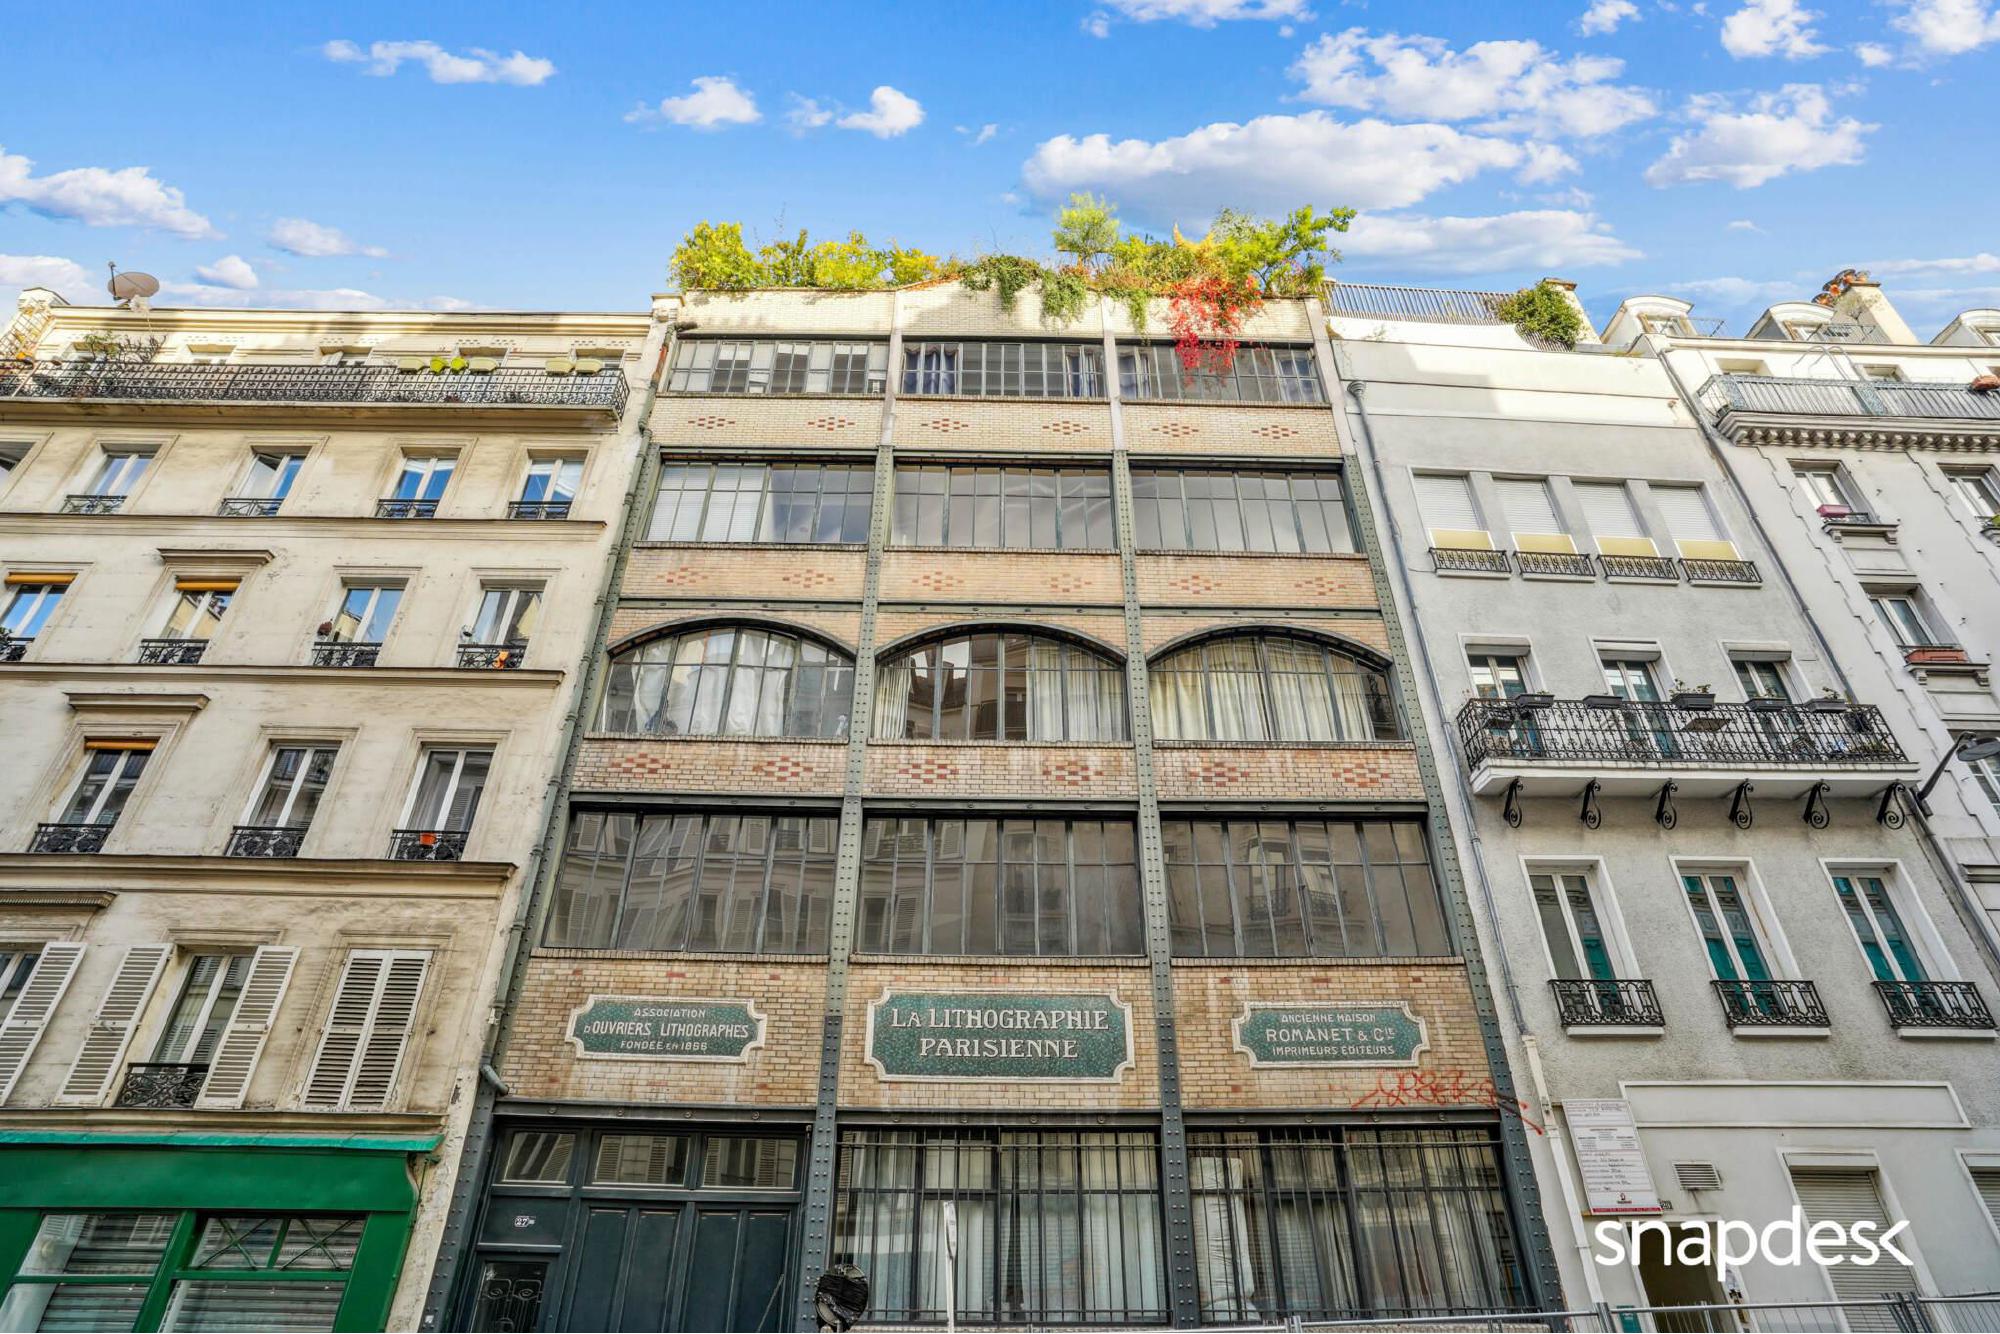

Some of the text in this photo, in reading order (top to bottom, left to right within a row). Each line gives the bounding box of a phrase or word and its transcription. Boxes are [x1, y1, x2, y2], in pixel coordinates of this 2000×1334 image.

[633, 1007, 706, 1018] ASSOCIATION
[891, 1008, 1109, 1030] LA LITHOGRAPHIE
[1281, 1013, 1376, 1023] ANCIENNE MAISON
[660, 1022, 749, 1038] LITHOGRAPHES
[1266, 1028, 1353, 1042] ROMANET
[1358, 1030, 1369, 1042] &
[919, 1038, 1079, 1058] PARISIENNE
[1272, 1045, 1338, 1056] IMPRIMEURS
